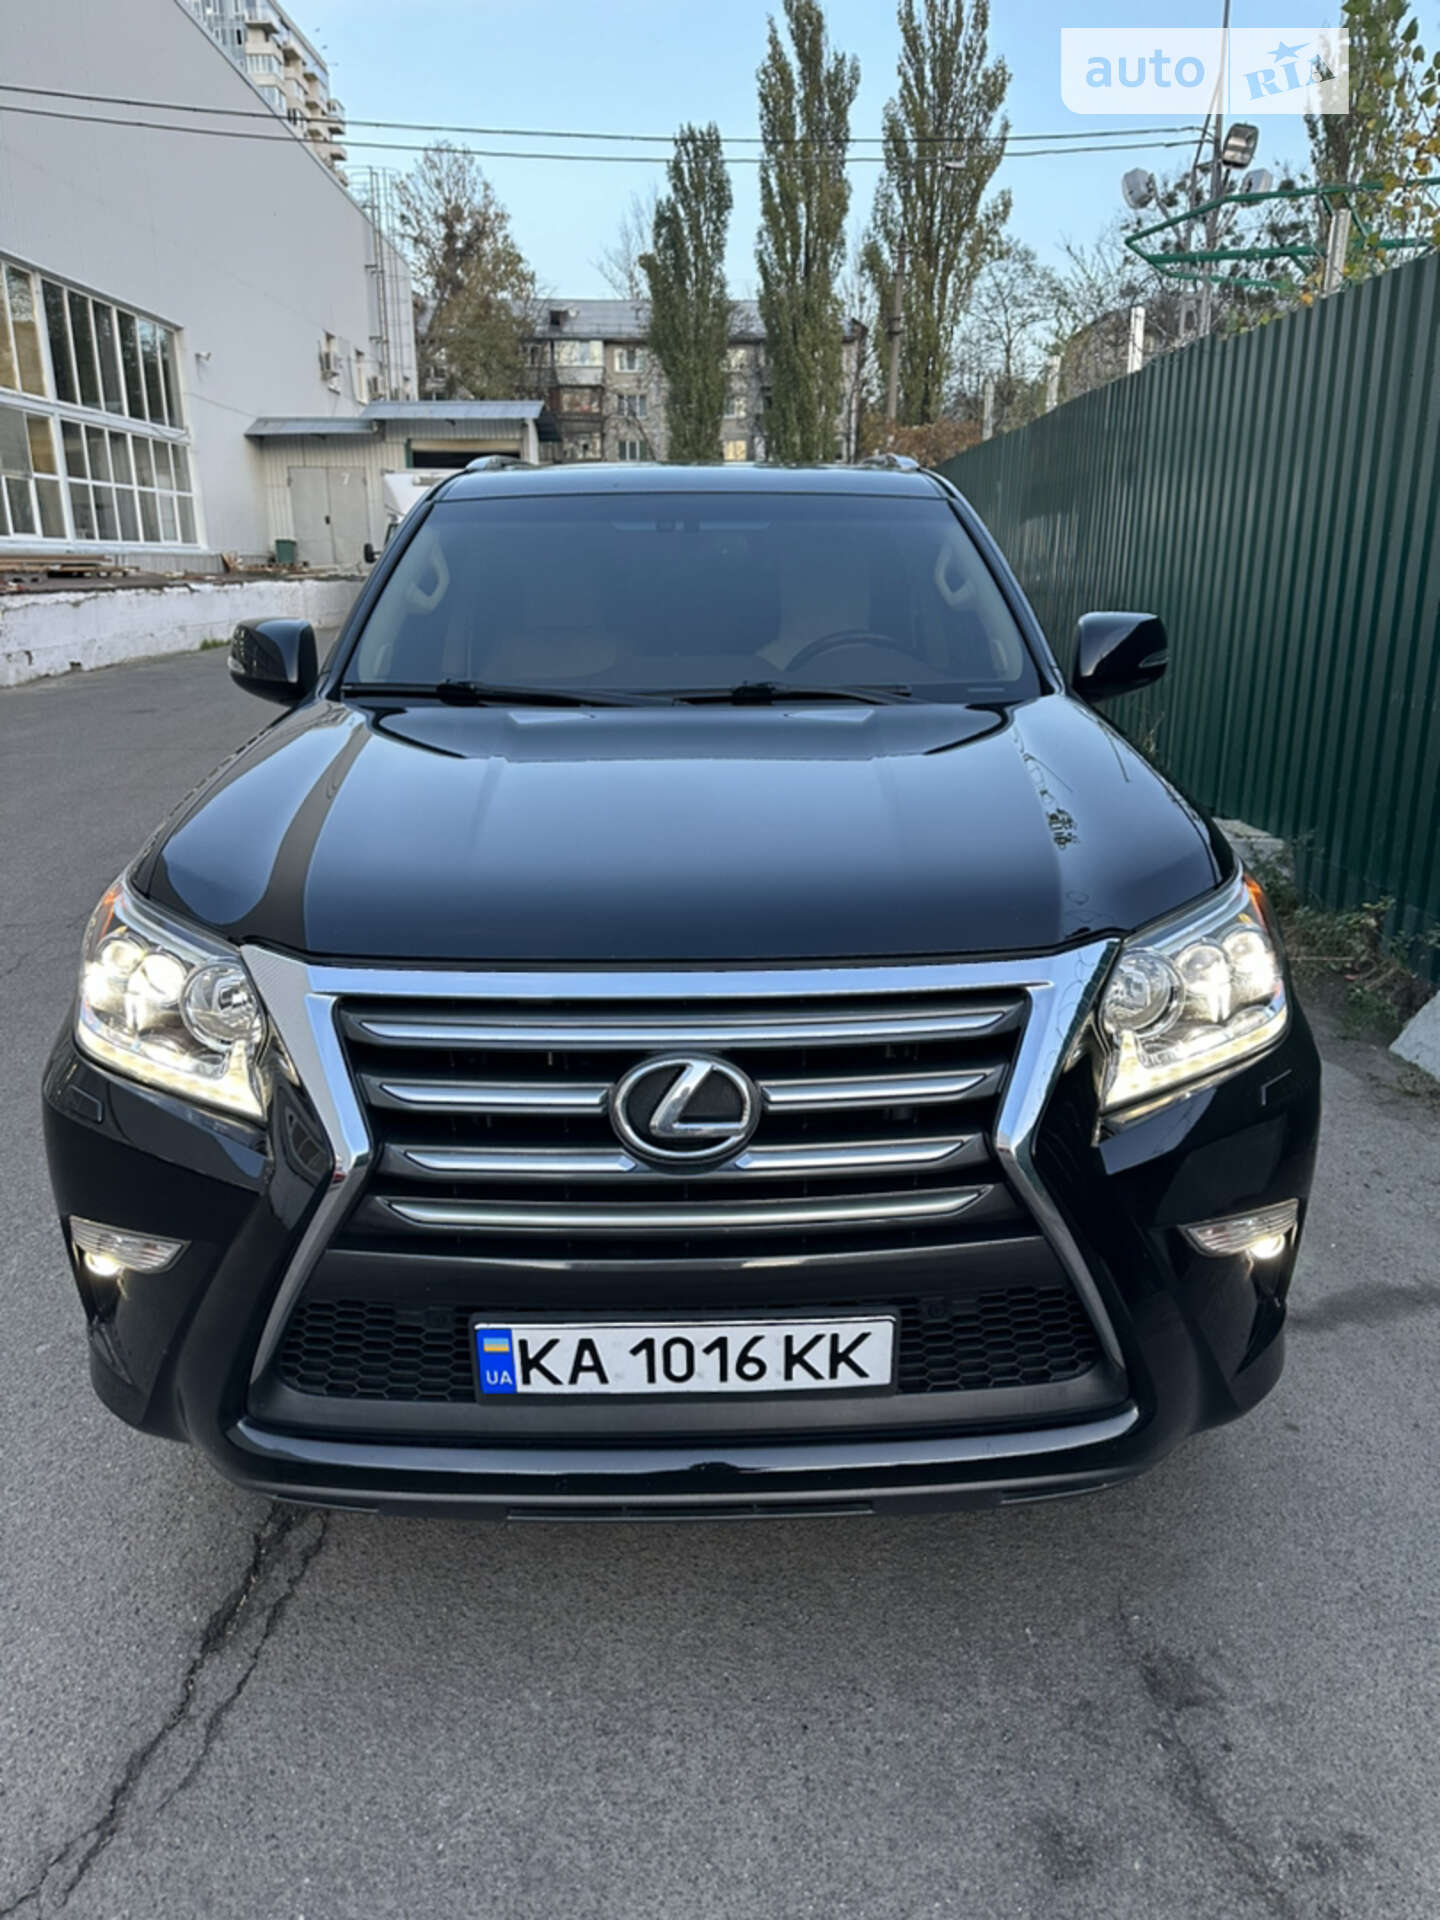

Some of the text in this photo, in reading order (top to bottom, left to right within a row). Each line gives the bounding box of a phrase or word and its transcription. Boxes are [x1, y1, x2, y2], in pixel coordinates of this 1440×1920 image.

[518, 1331, 872, 1386] KA 1016 KK
[486, 1370, 513, 1385] UA
